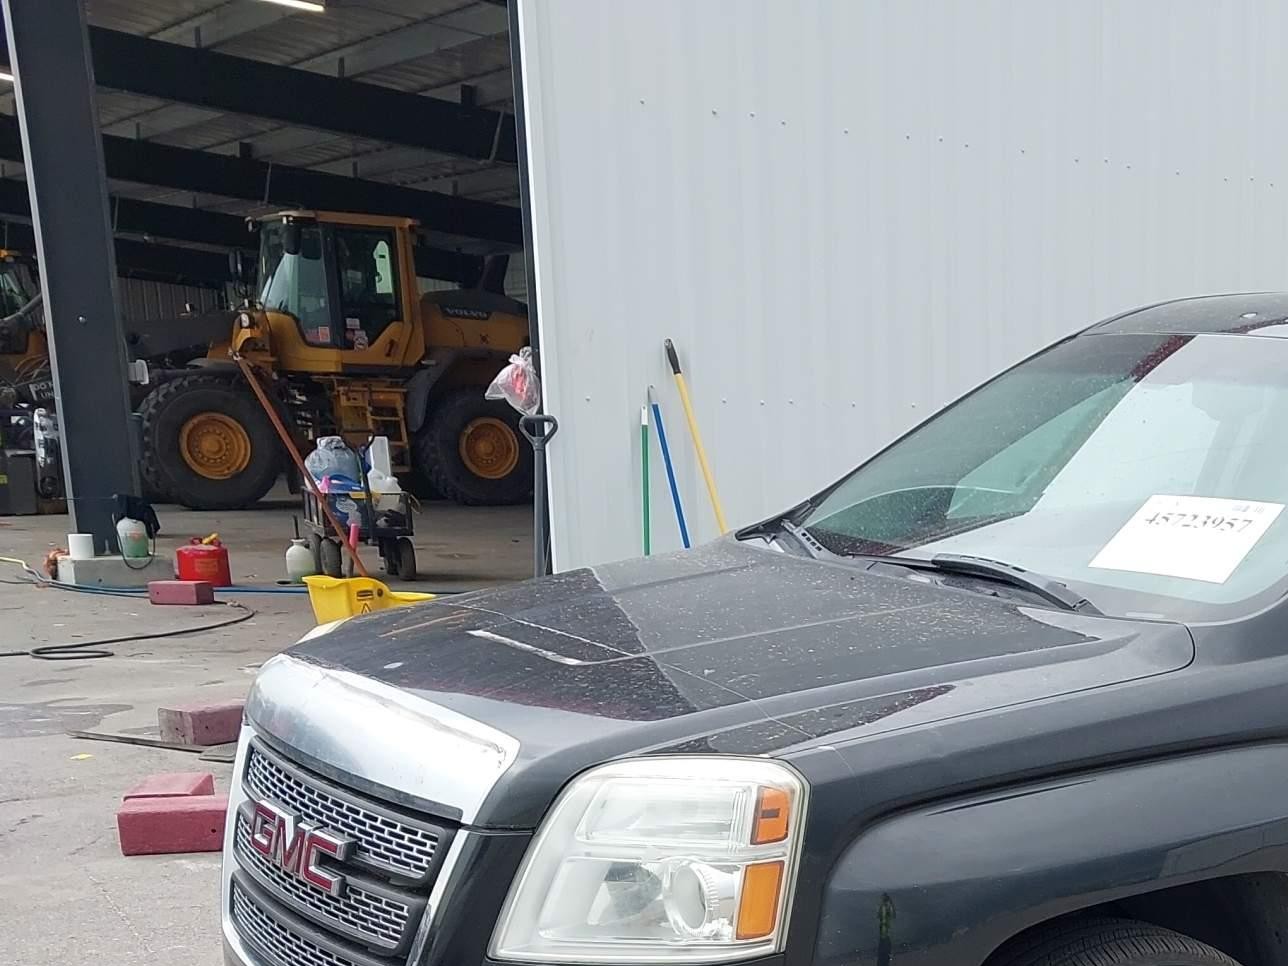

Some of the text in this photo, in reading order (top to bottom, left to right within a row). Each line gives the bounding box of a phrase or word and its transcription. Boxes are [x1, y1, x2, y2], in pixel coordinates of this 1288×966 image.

[446, 307, 488, 318] VOLVO
[1145, 511, 1254, 533] 45723957
[250, 800, 346, 896] GMC
